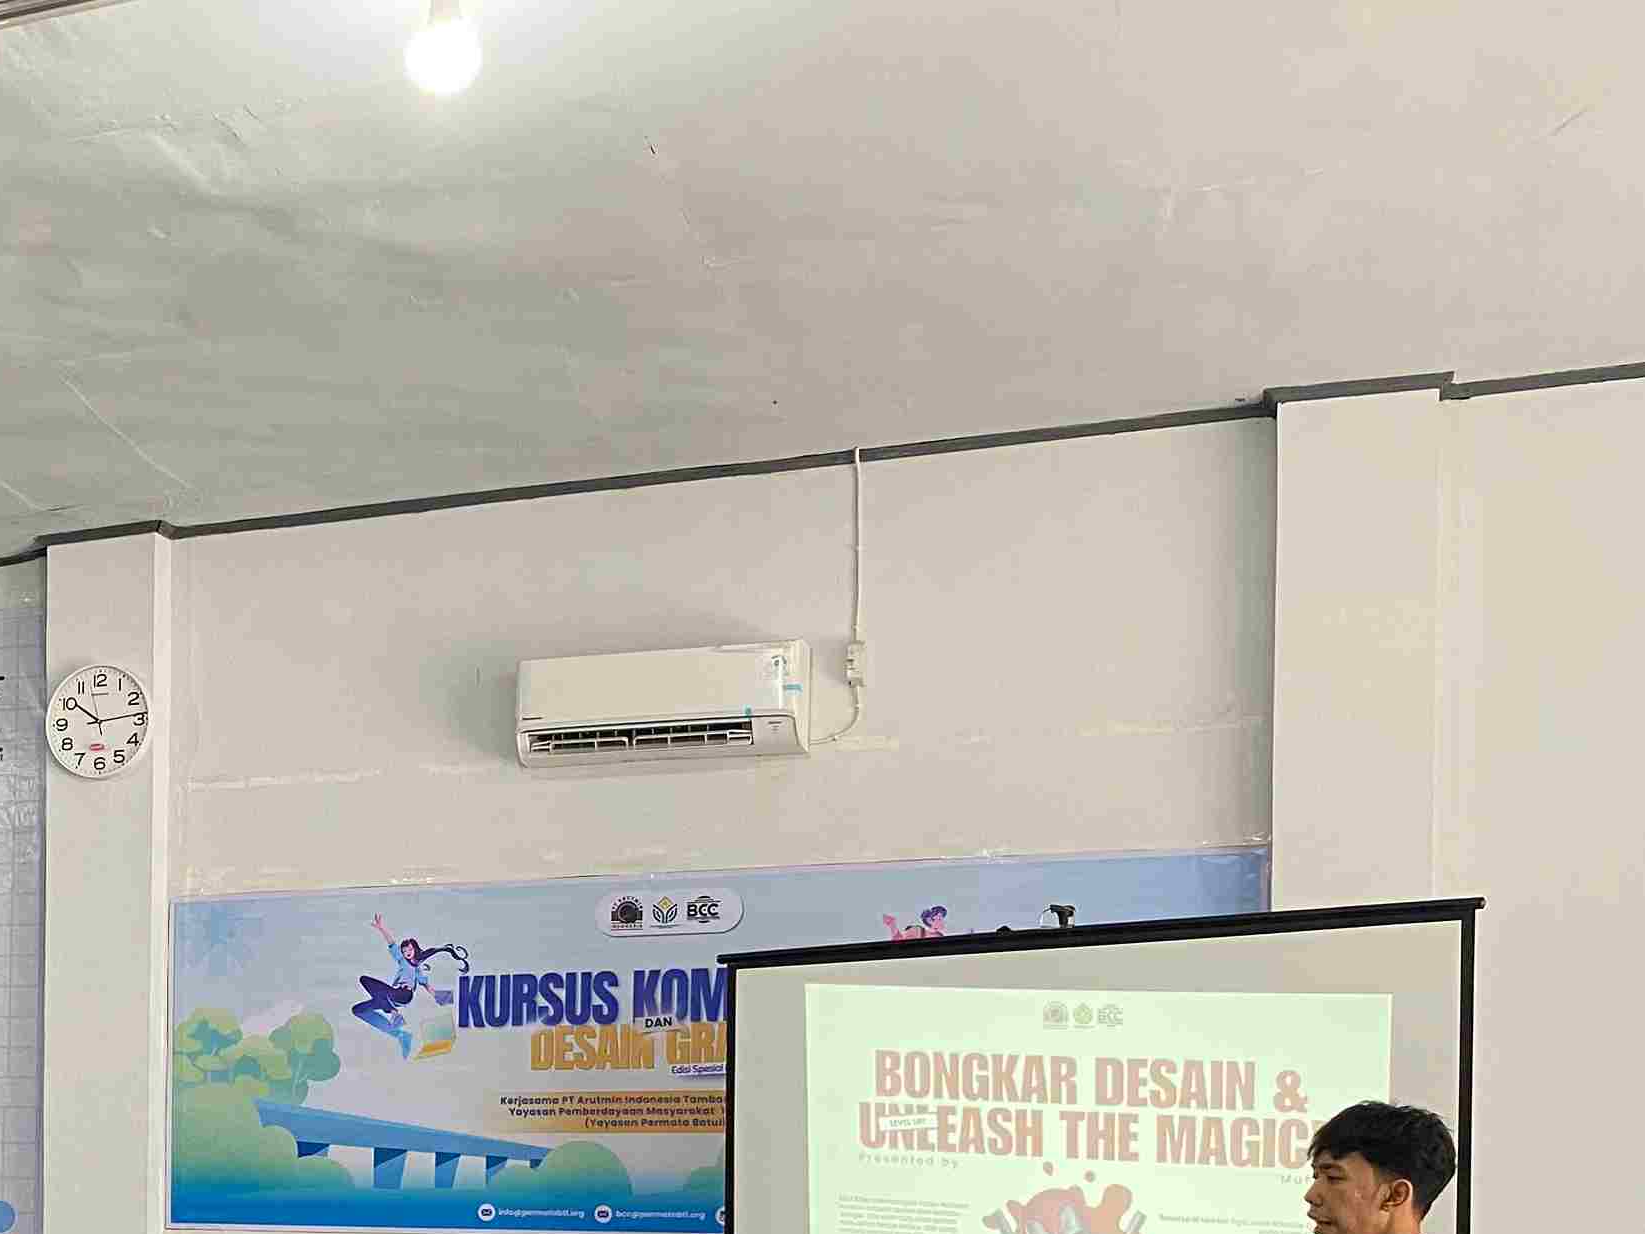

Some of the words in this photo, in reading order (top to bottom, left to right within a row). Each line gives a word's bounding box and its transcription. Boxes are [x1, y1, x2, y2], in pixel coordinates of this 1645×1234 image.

[77, 681, 85, 694] 11
[93, 673, 108, 688] 12
[62, 697, 78, 711] 10
[127, 692, 140, 706] 2
[56, 718, 68, 731] 9
[133, 711, 145, 726] 3
[61, 737, 73, 750] 8
[126, 732, 139, 747] 4
[74, 752, 86, 766] 7
[94, 756, 106, 770] 6
[113, 749, 125, 763] 5
[687, 903, 719, 917] BCC
[458, 971, 619, 1028] KURSUS
[644, 1016, 672, 1029] DAN
[531, 1023, 654, 1071] DESAIN
[875, 1049, 1077, 1104] BONGKAR
[1095, 1056, 1255, 1111] DESAIN
[1273, 1070, 1309, 1113] &
[500, 1096, 559, 1107] Kerjasama
[562, 1096, 574, 1104] PT
[577, 1096, 622, 1104] Arutmin
[625, 1095, 680, 1104] Indonesia
[508, 1107, 555, 1118] Yayasan
[558, 1107, 643, 1117] Pemberdayaan
[646, 1106, 715, 1117] Masyarakat
[858, 1101, 1043, 1157] UNLEASH
[1059, 1110, 1139, 1161] THE
[858, 1153, 933, 1168] Presented
